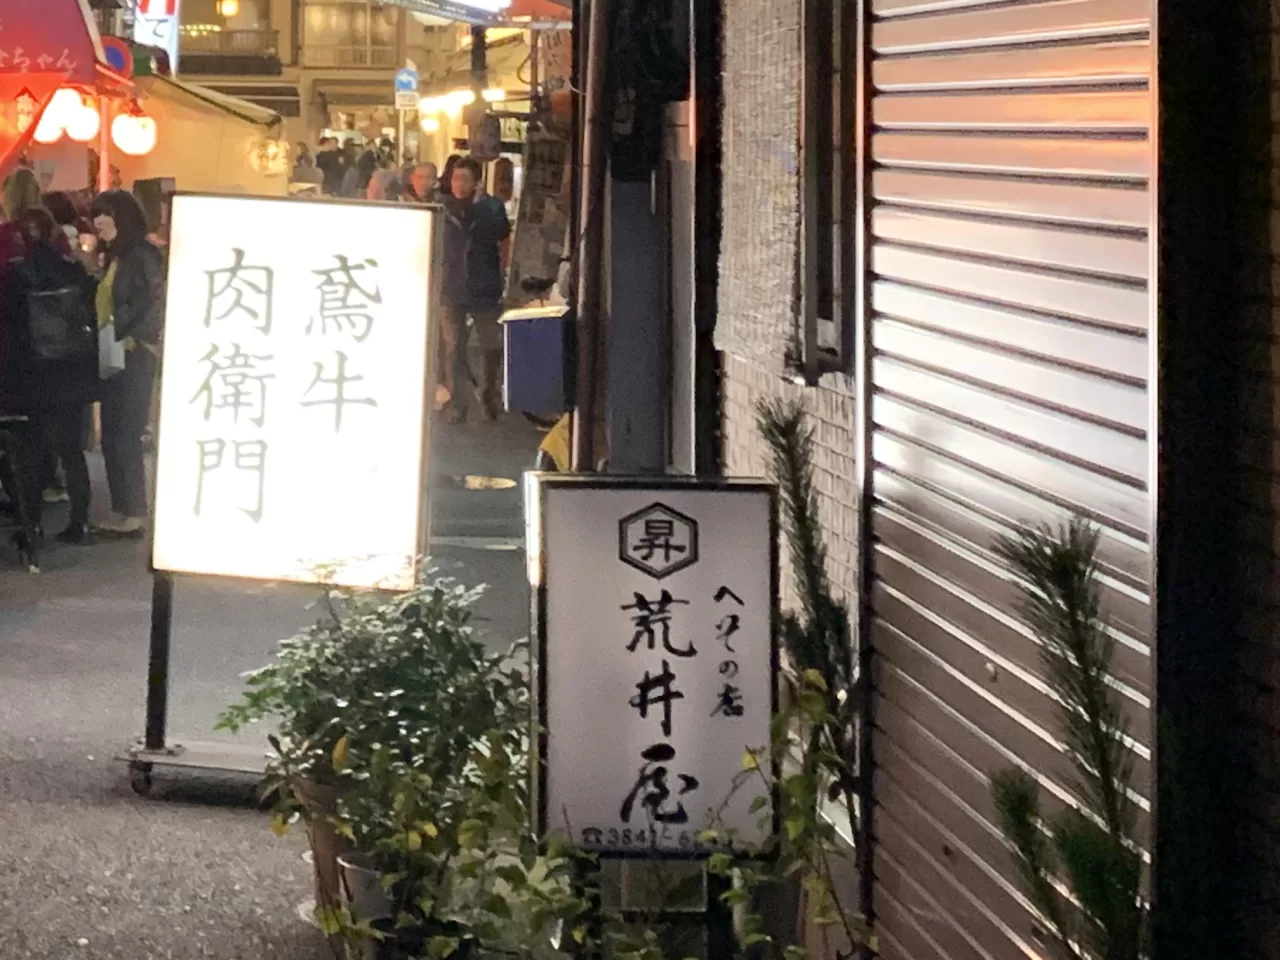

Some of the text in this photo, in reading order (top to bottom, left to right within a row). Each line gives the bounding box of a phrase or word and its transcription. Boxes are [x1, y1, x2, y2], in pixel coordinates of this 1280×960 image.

[188, 247, 276, 522] 肉衛門
[297, 253, 383, 435] 鳶牛
[620, 588, 699, 825] 荒井屋
